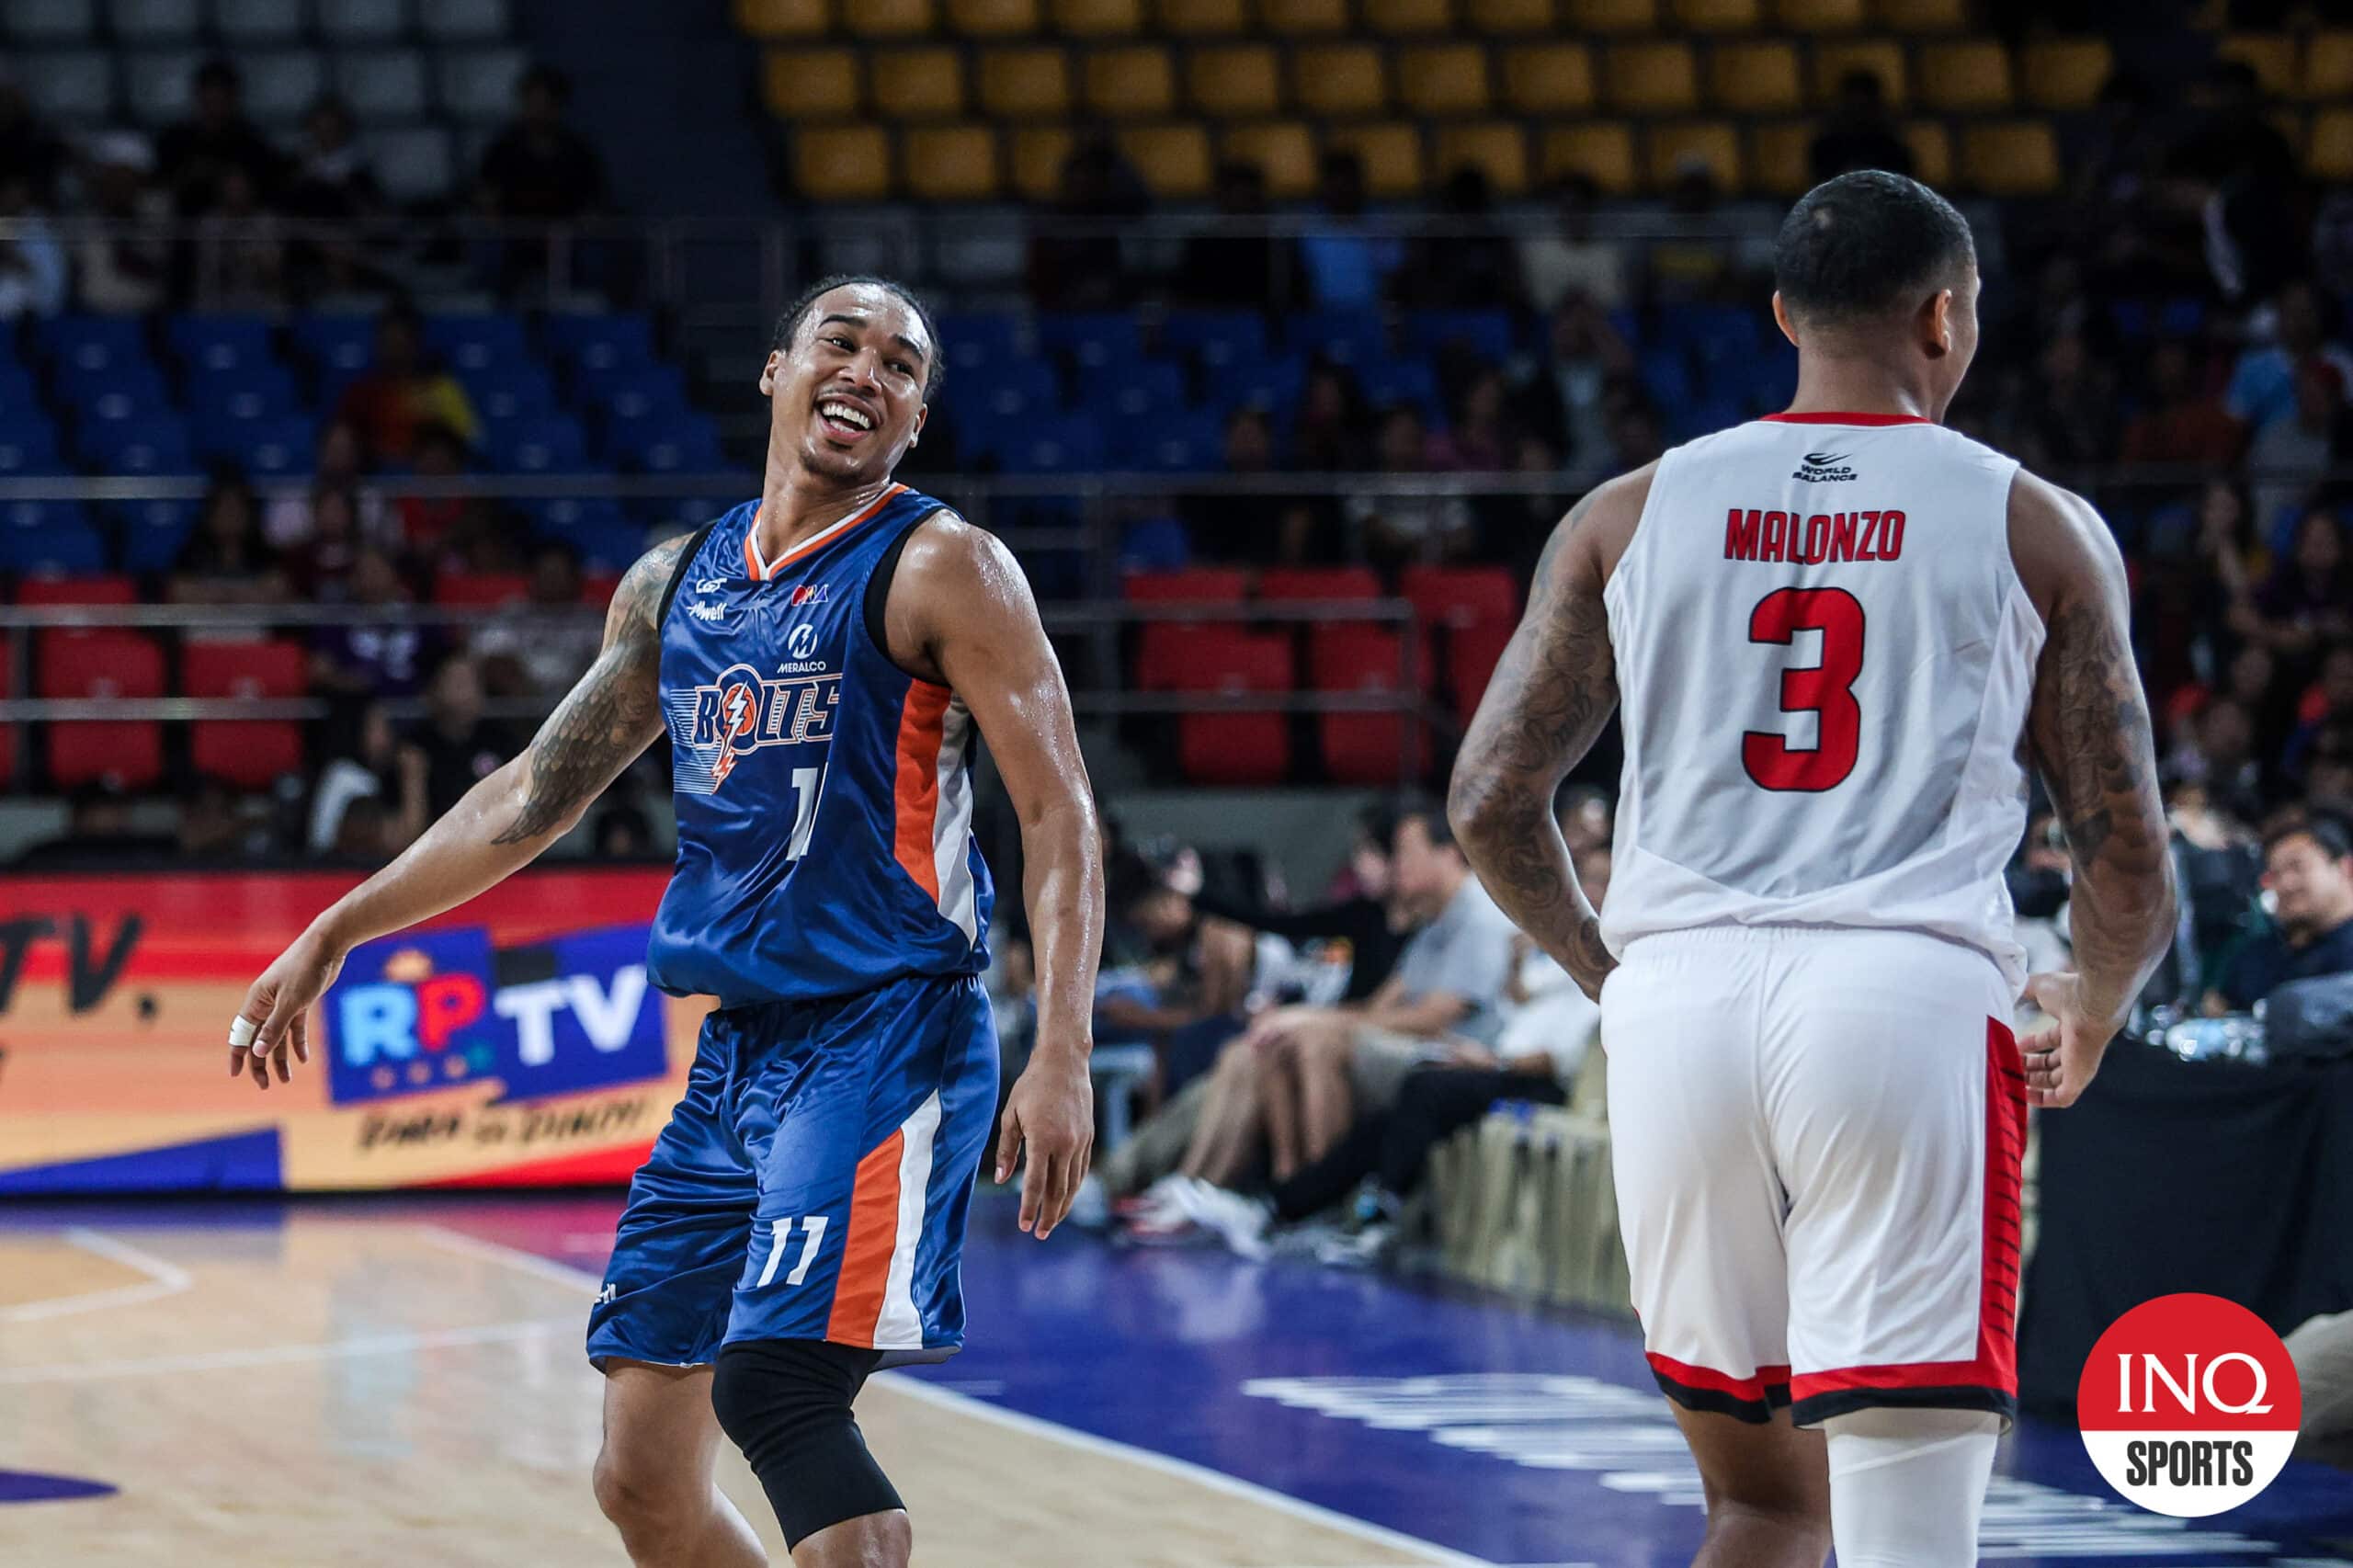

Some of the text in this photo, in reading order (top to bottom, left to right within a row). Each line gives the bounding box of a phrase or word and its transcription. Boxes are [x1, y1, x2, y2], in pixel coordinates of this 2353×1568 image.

[1791, 472, 1859, 483] BALANCE
[1802, 464, 1852, 475] WORLD
[1724, 509, 1906, 565] MALONZO
[777, 661, 826, 674] MERALCO
[1742, 586, 1866, 791] 3
[691, 664, 843, 756] BOLTS
[756, 1216, 829, 1288] 11
